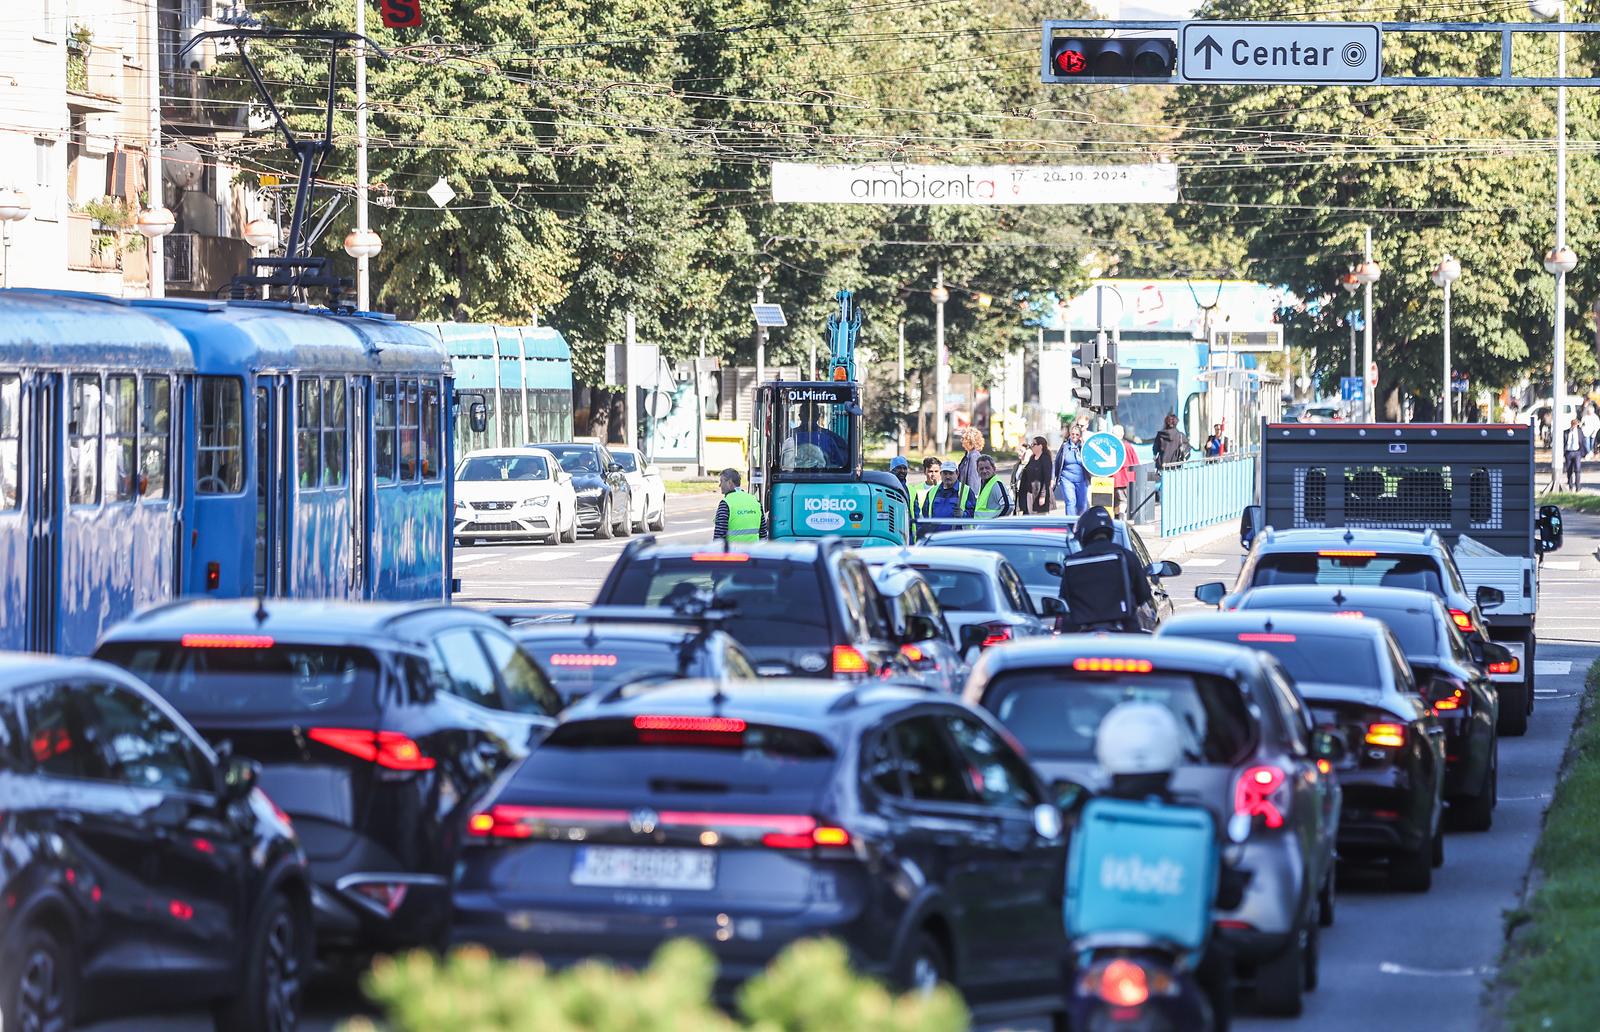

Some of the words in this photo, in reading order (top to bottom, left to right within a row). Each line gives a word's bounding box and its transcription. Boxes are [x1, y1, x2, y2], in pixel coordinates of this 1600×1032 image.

[1231, 39, 1335, 66] Centar
[850, 169, 995, 199] ambienta
[788, 389, 838, 401] OLMinfra
[804, 498, 858, 512] KOBELCO
